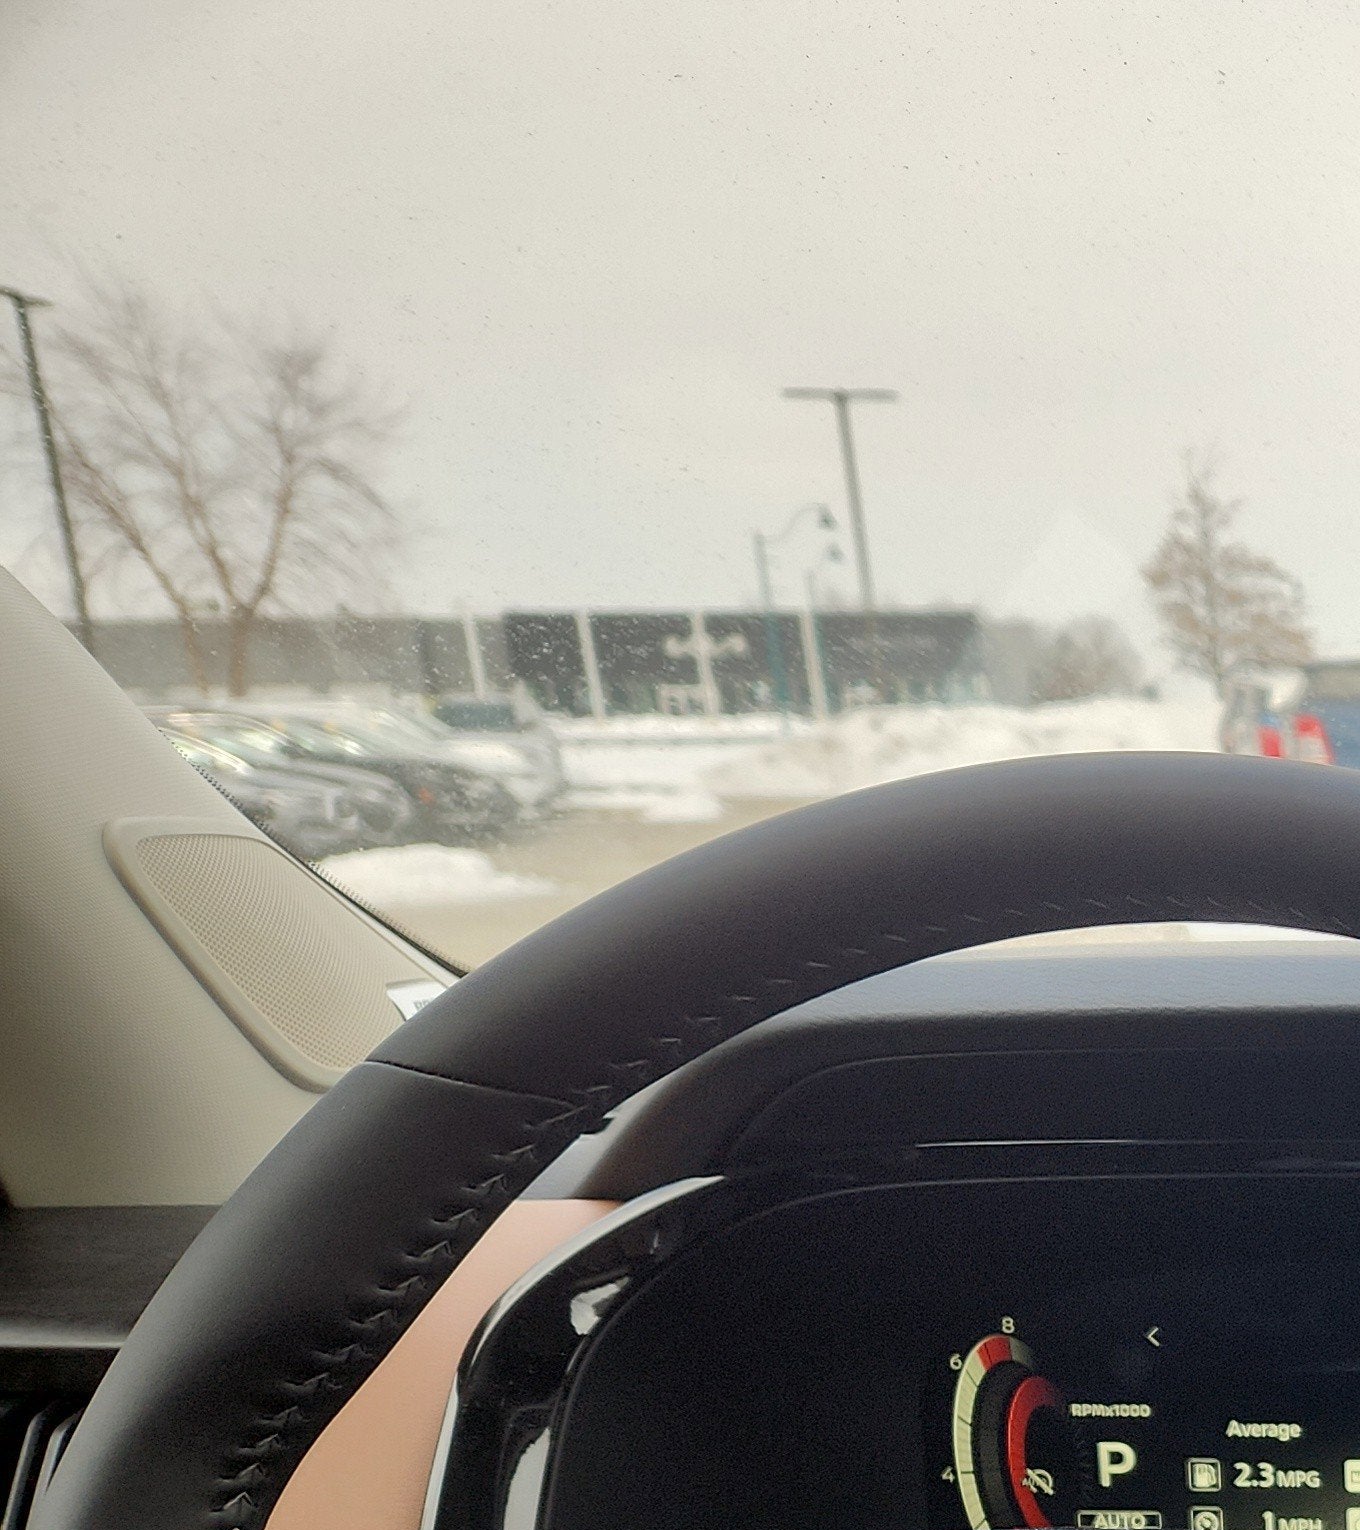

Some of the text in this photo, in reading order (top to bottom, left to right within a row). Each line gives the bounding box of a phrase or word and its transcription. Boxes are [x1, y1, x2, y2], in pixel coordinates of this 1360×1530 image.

[1002, 1316, 1015, 1334] 8
[950, 1354, 962, 1370] 6
[1226, 1420, 1302, 1441] Average
[1097, 1441, 1137, 1487] P
[942, 1467, 955, 1483] 4
[1094, 1512, 1147, 1529] AUTO
